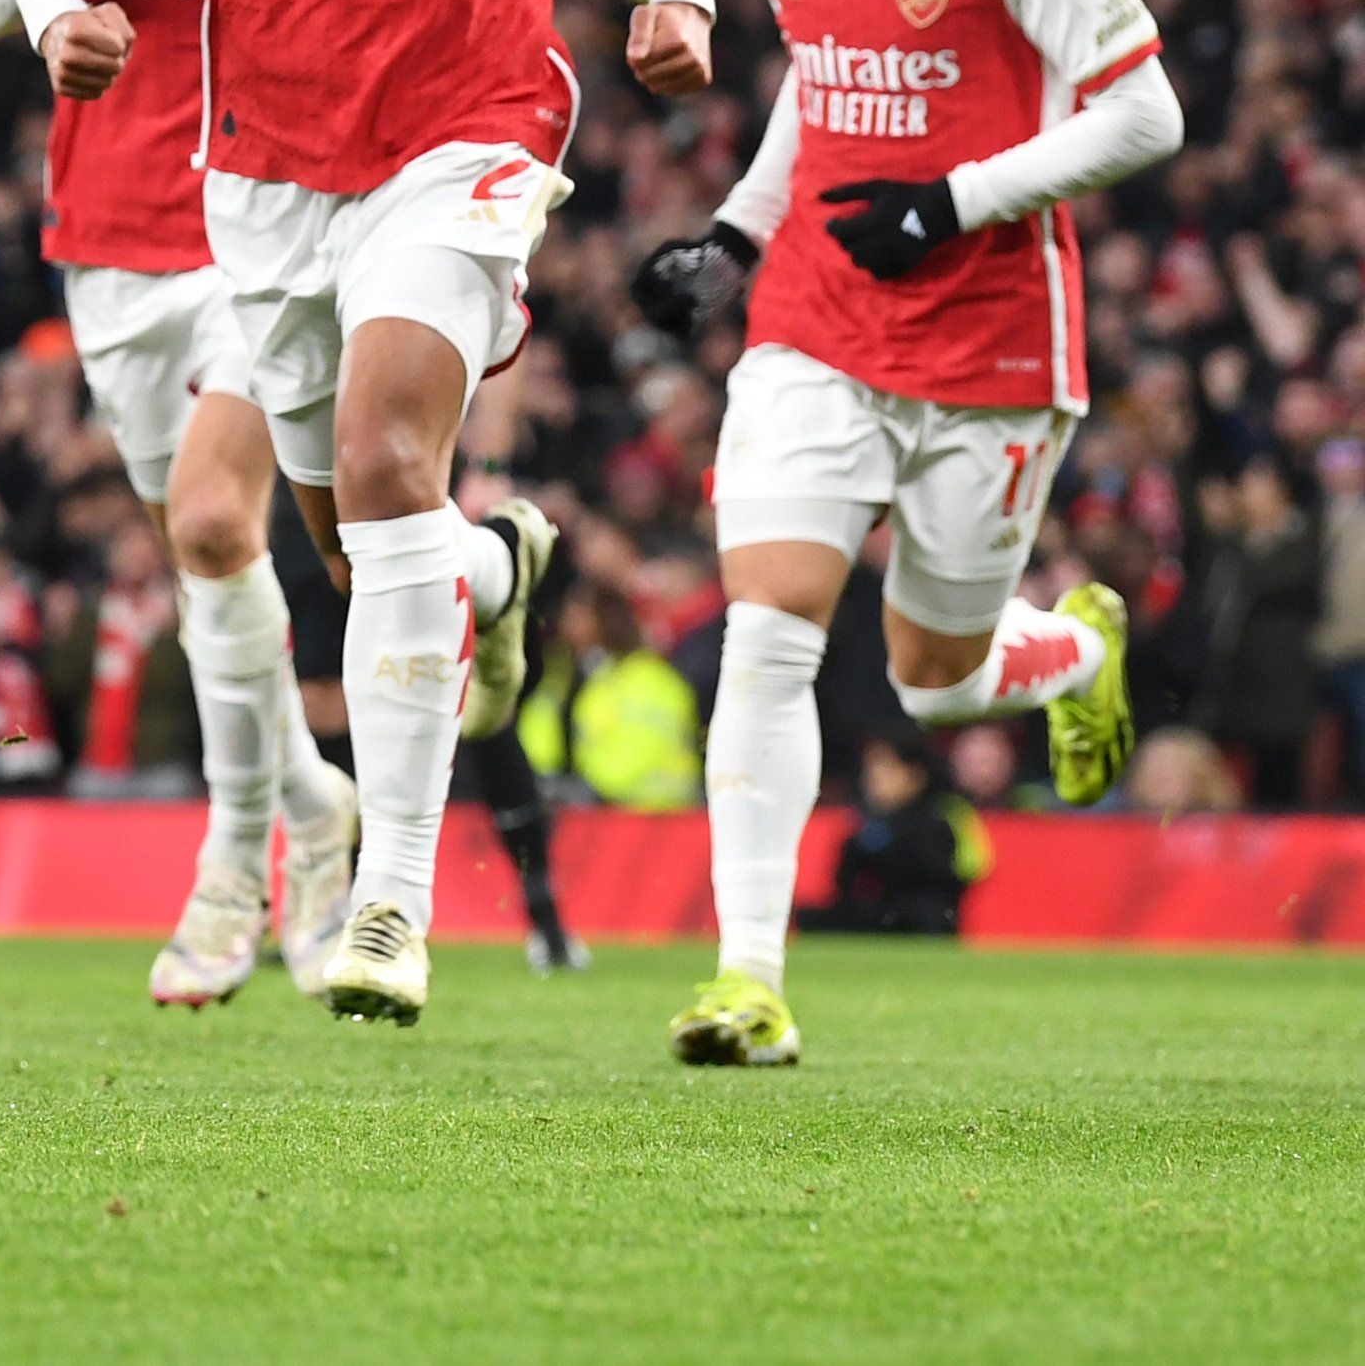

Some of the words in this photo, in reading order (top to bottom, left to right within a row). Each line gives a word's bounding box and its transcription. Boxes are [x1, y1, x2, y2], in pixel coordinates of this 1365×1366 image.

[789, 33, 961, 91] mirates
[827, 90, 929, 137] BETTER
[472, 158, 532, 200] 2
[1002, 439, 1048, 518] 11
[375, 652, 455, 687] AFC
